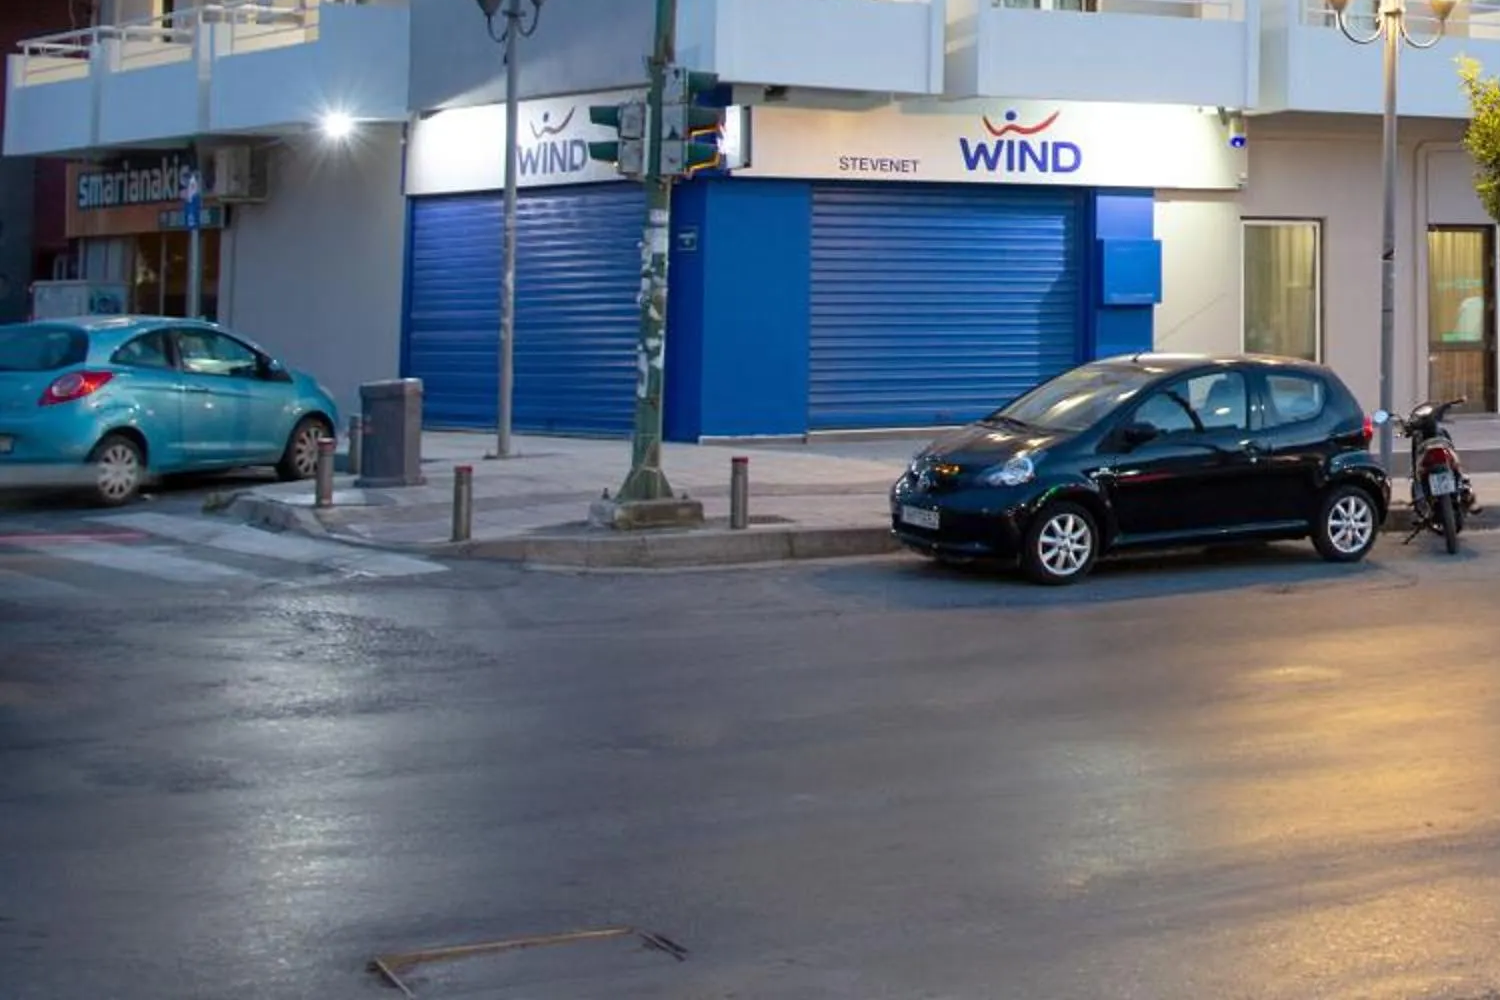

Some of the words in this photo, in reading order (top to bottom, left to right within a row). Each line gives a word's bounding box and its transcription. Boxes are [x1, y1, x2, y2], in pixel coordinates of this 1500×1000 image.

[517, 139, 588, 176] WIND
[839, 155, 920, 173] STEVENET
[960, 137, 1082, 173] WIND
